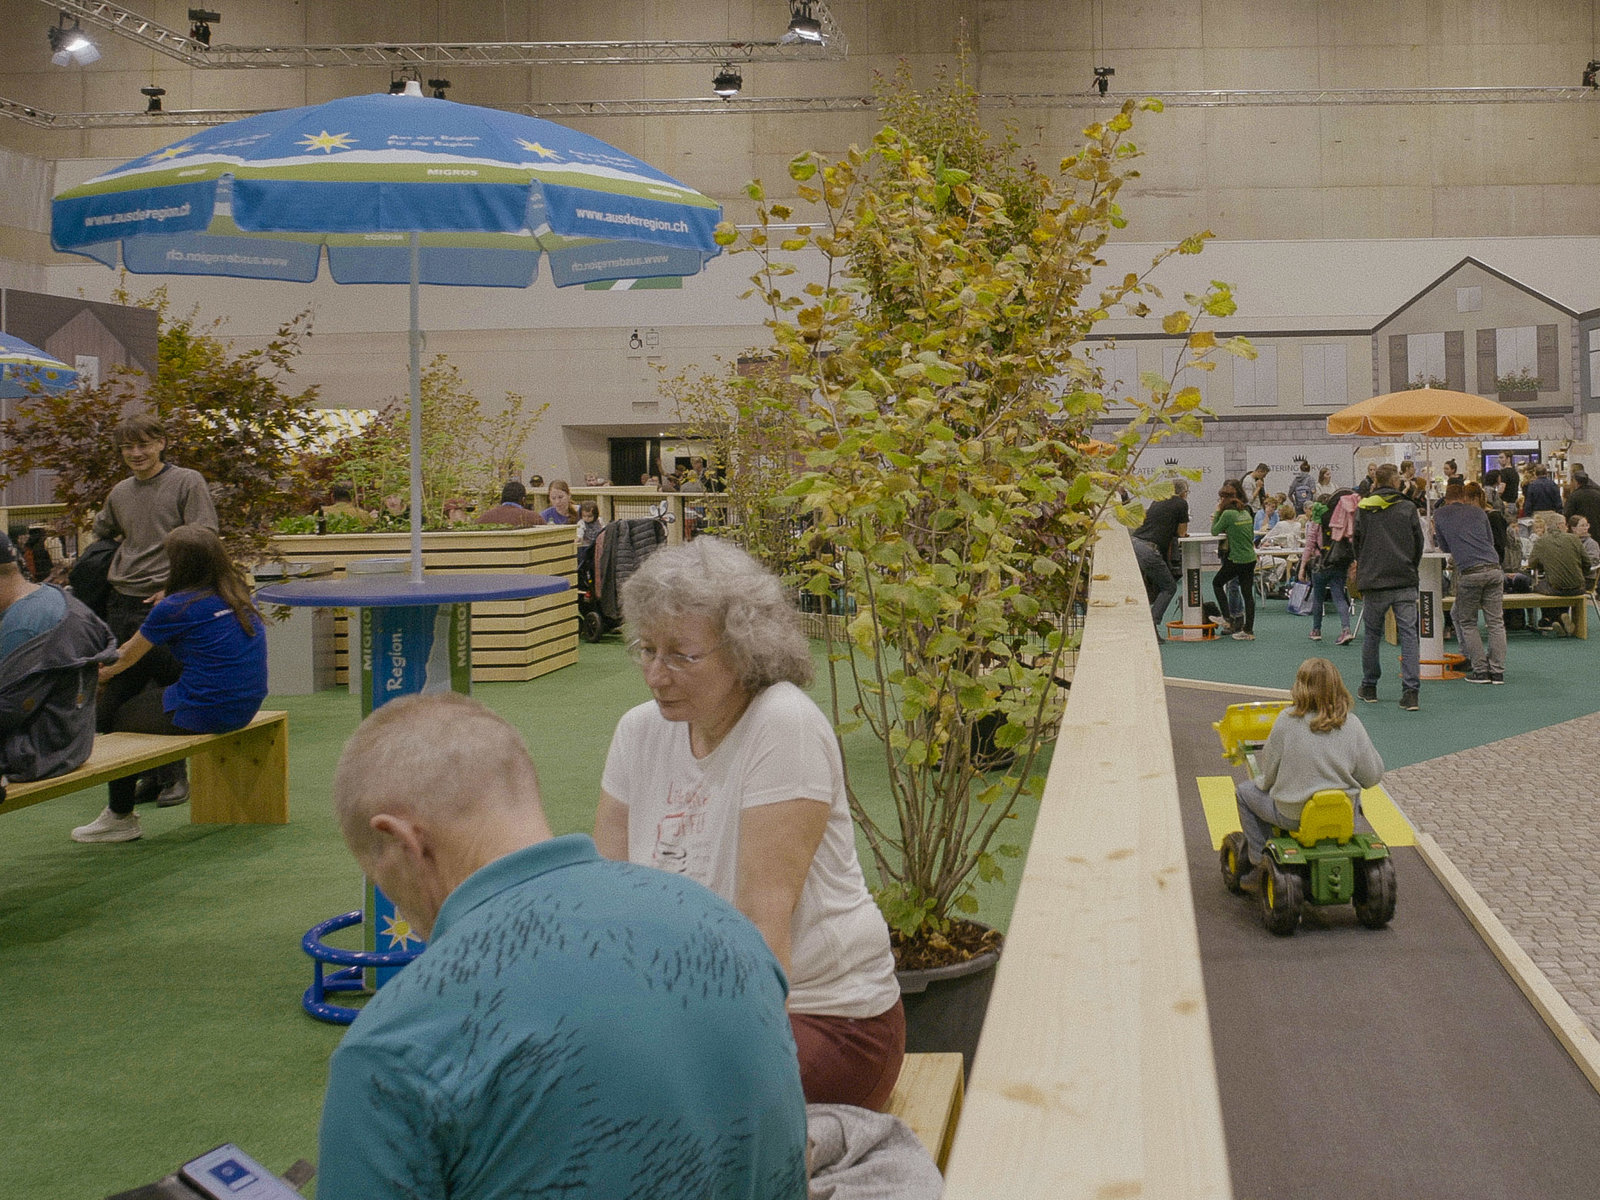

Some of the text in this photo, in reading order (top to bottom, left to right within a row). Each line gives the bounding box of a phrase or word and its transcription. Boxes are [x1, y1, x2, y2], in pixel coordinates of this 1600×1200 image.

[427, 168, 479, 177] MIGROS
[575, 208, 689, 233] www.ausderregion.ch
[1415, 441, 1465, 451] SERVICES
[1266, 464, 1300, 472] ATERING
[362, 607, 373, 671] MIGRO
